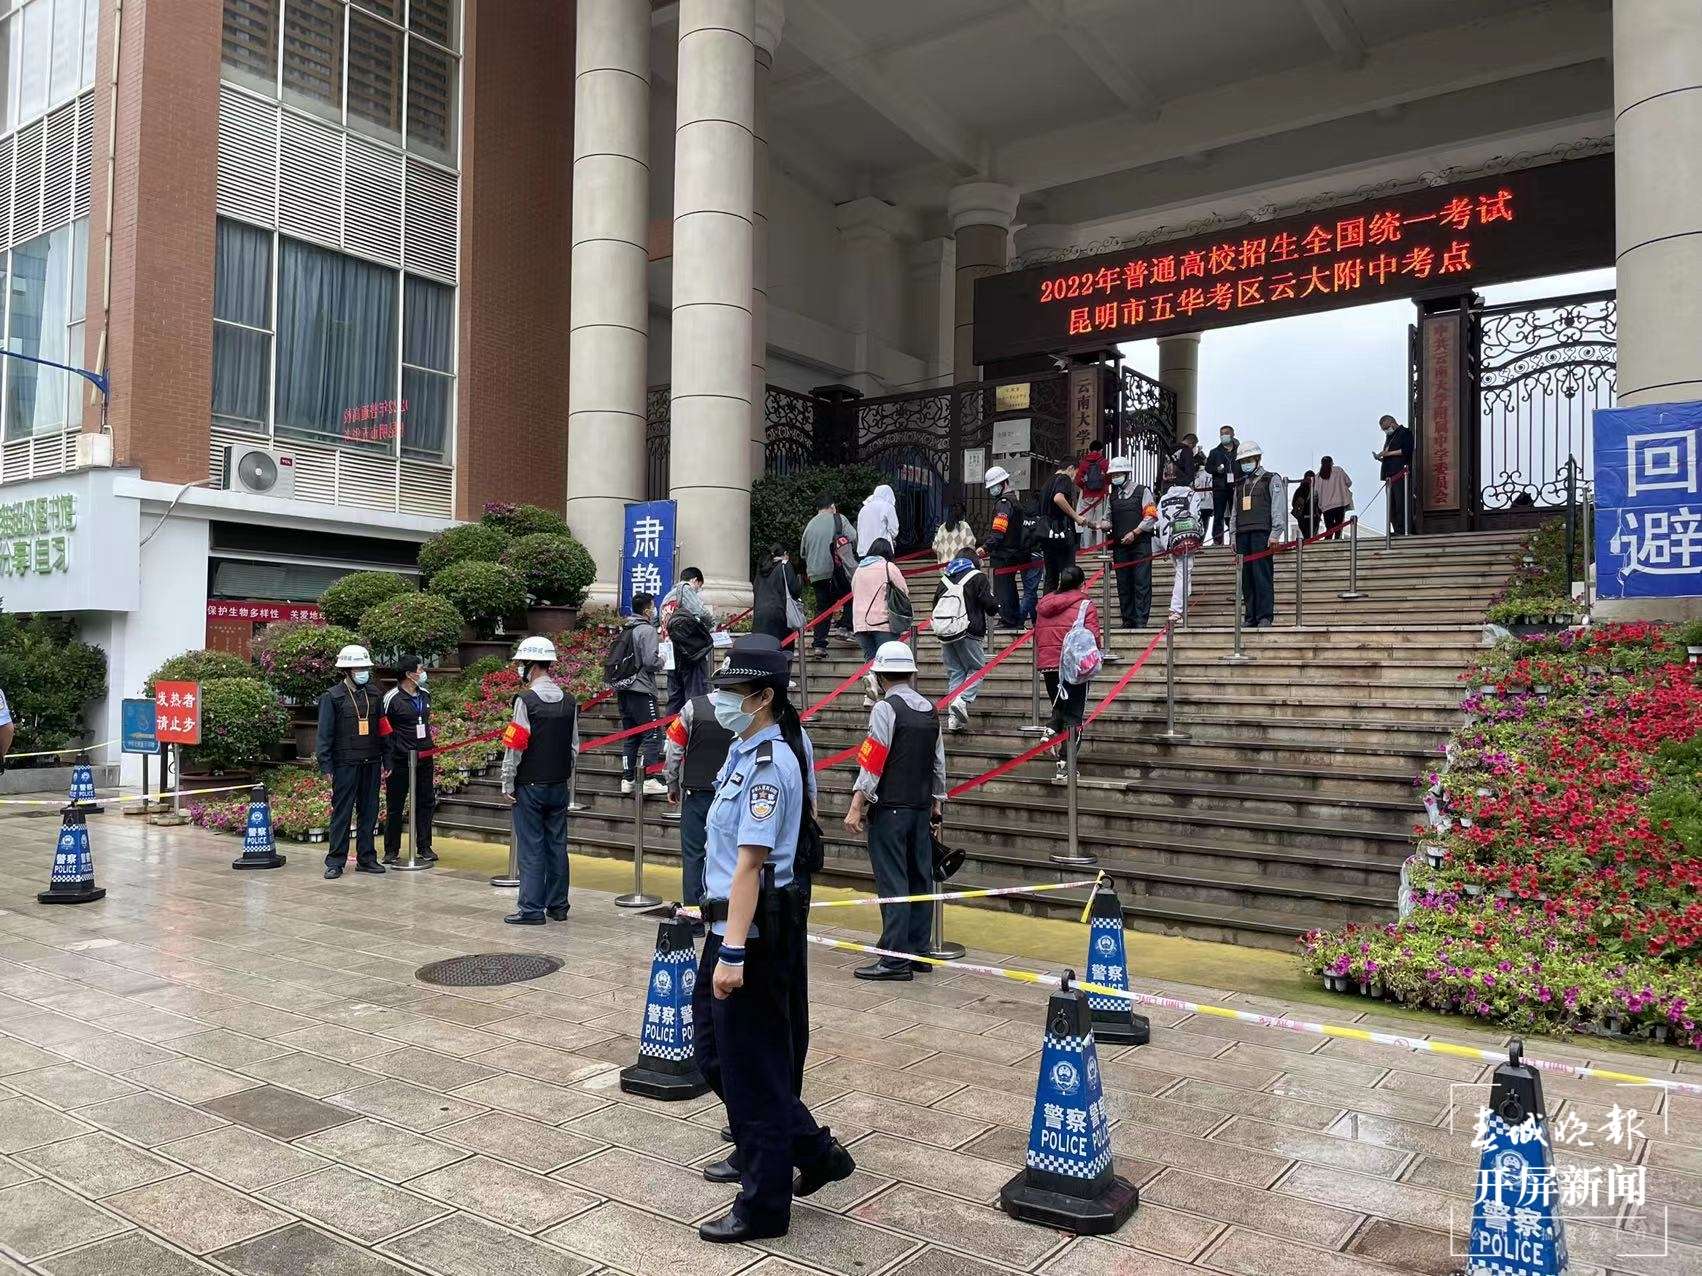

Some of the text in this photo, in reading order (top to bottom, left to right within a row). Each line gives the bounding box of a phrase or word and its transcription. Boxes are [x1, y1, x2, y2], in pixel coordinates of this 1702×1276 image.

[1040, 190, 1514, 303] 2022年普通高校招生全国统一考试
[1068, 240, 1473, 336] 昆明市五华考区云大附中考点
[1621, 429, 1702, 576] 回避
[631, 515, 664, 597] 肃静
[207, 605, 279, 619] 保护生物多样性
[157, 691, 195, 708] 发热者
[157, 715, 195, 732] 请止步
[247, 836, 267, 844] POLICE
[53, 864, 77, 873] POLICE
[56, 853, 77, 864] 警察
[1091, 963, 1123, 981] 警察
[647, 1003, 676, 1025] 警察
[644, 1024, 675, 1043] POLICE
[1043, 1102, 1087, 1134] 警察
[1041, 1129, 1088, 1157] POLICE
[1482, 1199, 1543, 1238] 警察
[1479, 1229, 1544, 1266] POLICE
